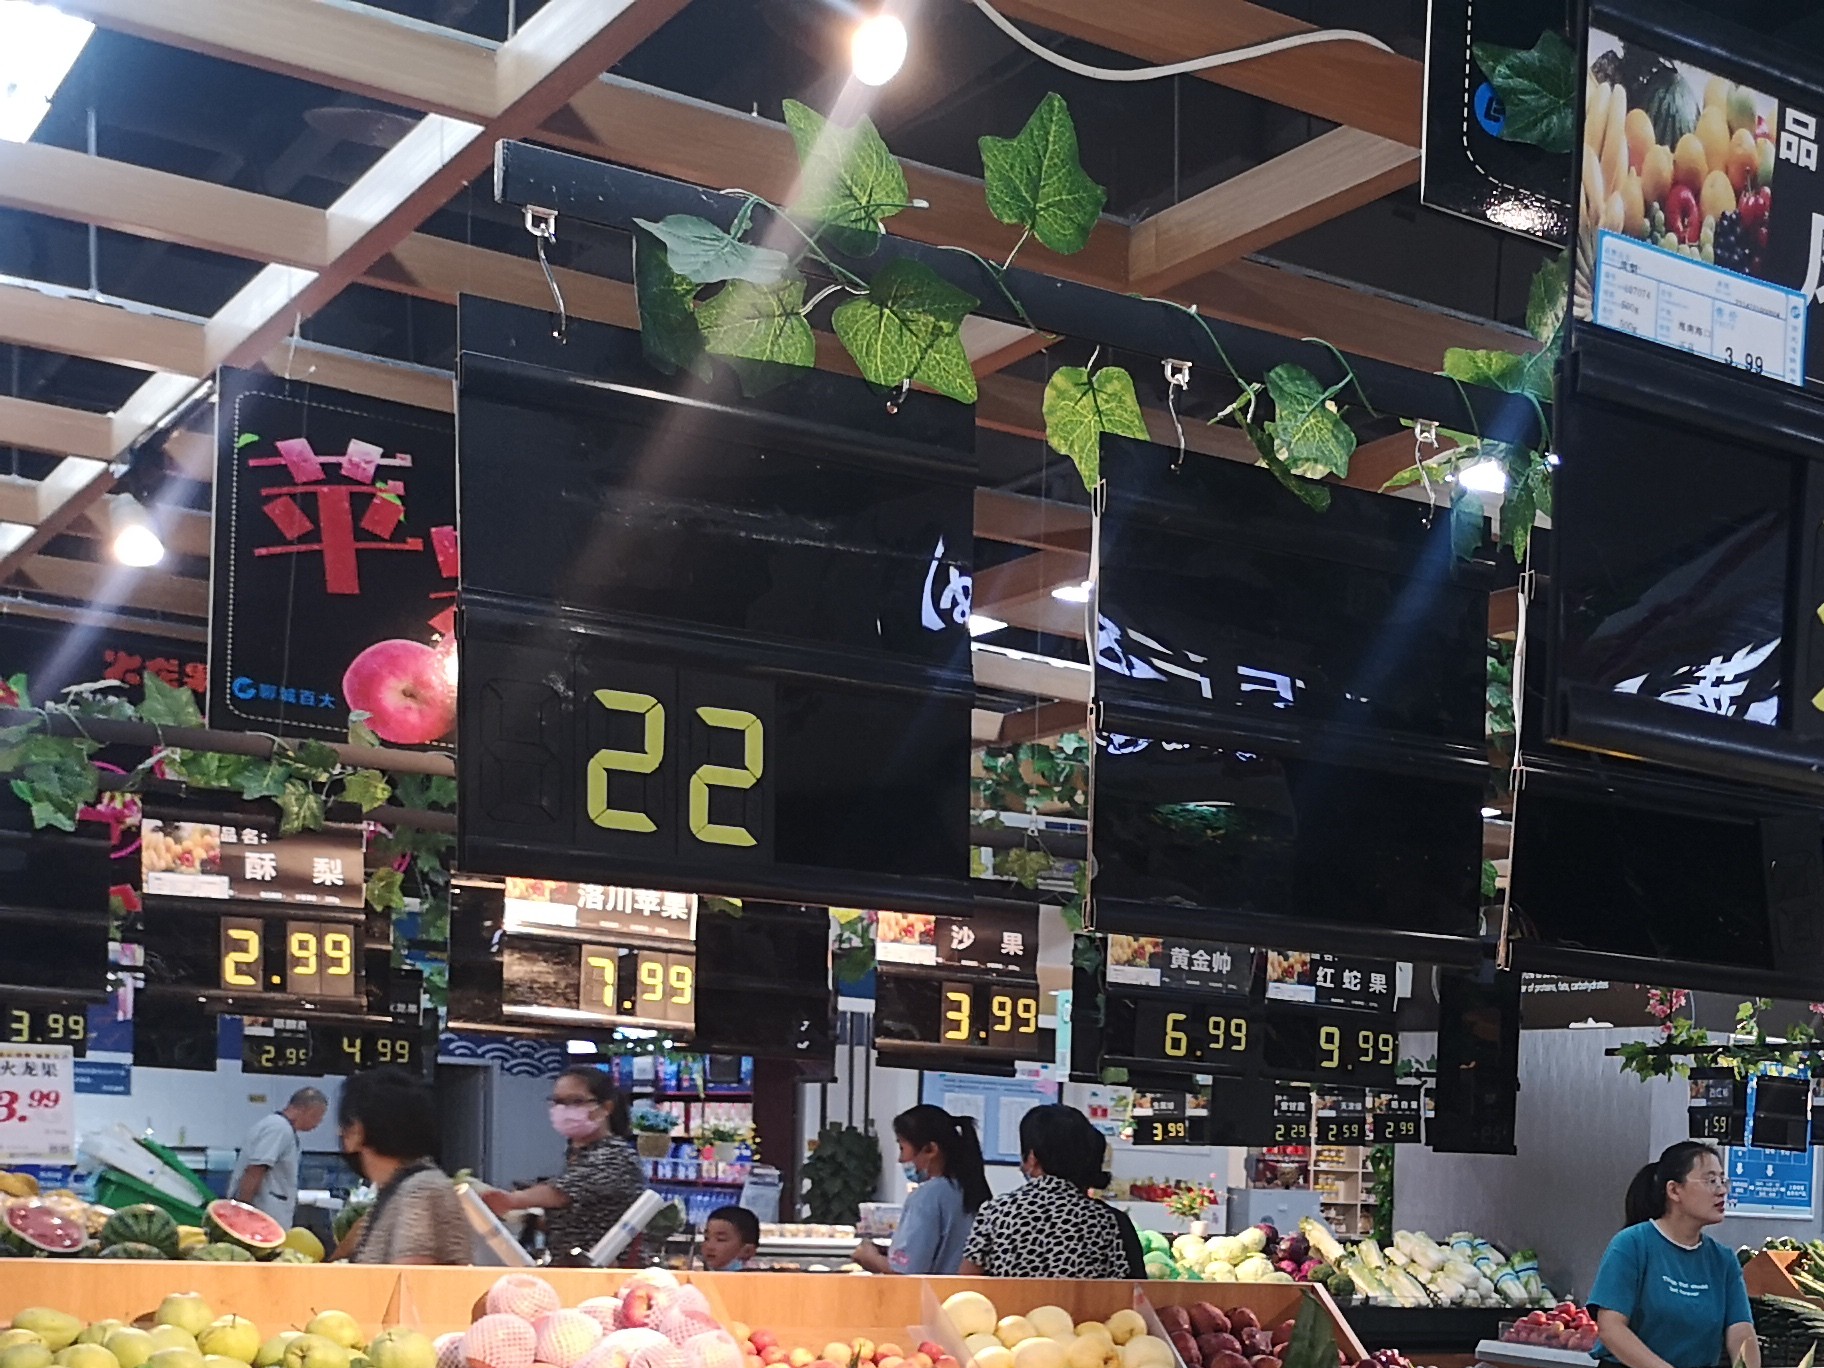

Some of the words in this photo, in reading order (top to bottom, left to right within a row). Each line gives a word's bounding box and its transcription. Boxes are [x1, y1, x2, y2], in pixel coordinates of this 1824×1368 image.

[1724, 346, 1763, 374] 3.99
[587, 689, 763, 847] 22
[244, 852, 344, 887] 酥梨
[577, 884, 689, 920] 洛川苹果
[951, 924, 1024, 956] 沙果
[224, 929, 351, 986] 2.99
[1169, 947, 1233, 974] 黄金帅
[587, 957, 693, 1009] 7.99
[1316, 966, 1388, 994] 红蛇果
[10, 1009, 85, 1042] 3.99
[945, 992, 1037, 1040] 3.99
[343, 1037, 410, 1065] 4.99
[1164, 1013, 1247, 1057] 6.99
[1319, 1026, 1393, 1071] 9.99
[1, 1061, 59, 1077] 火龙果
[1152, 1122, 1185, 1141] 3.99
